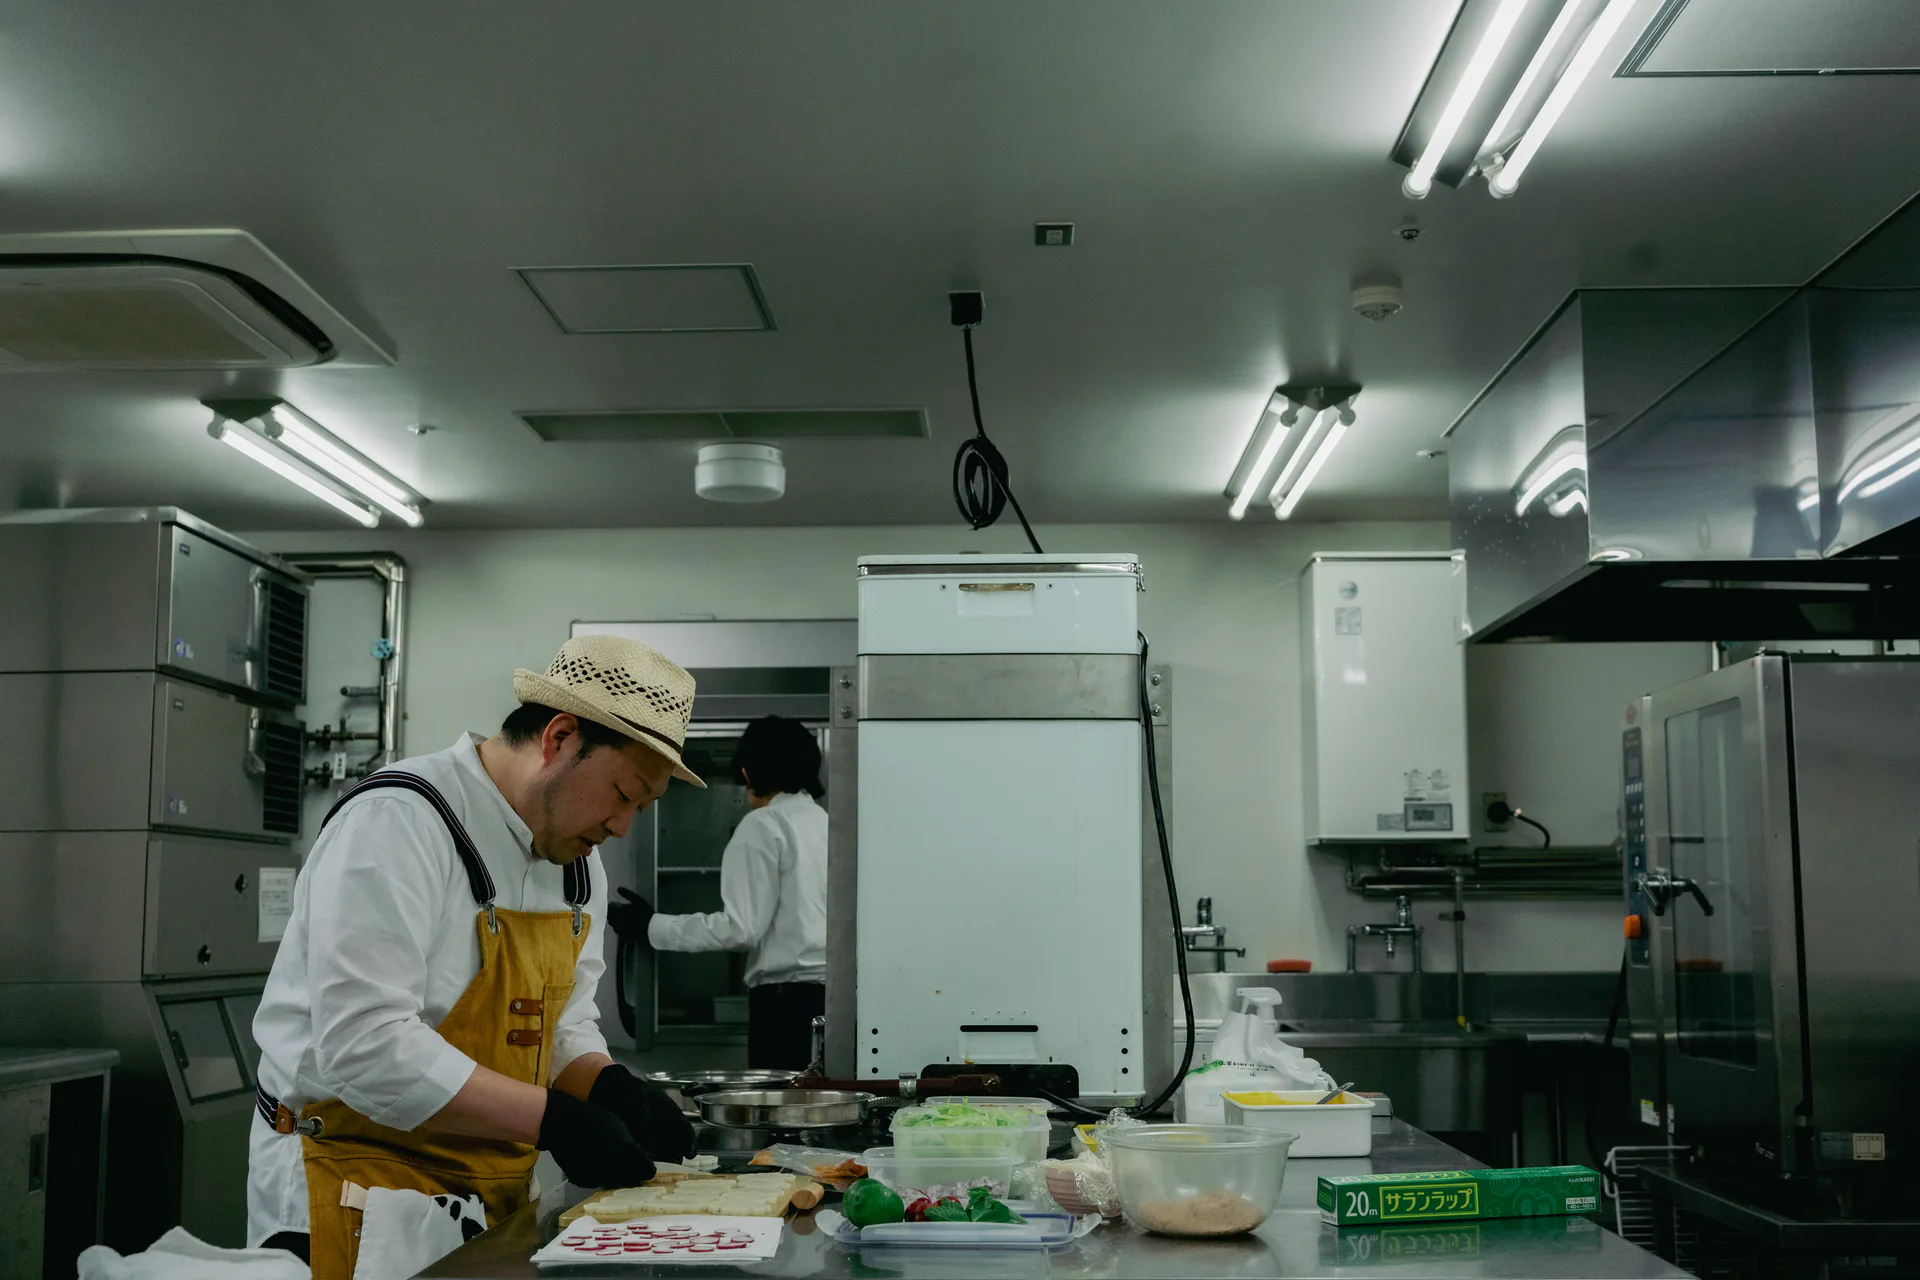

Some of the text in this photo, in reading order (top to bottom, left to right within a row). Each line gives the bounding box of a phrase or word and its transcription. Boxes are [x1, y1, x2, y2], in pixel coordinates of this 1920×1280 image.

[1385, 1188, 1472, 1212] サランラップ
